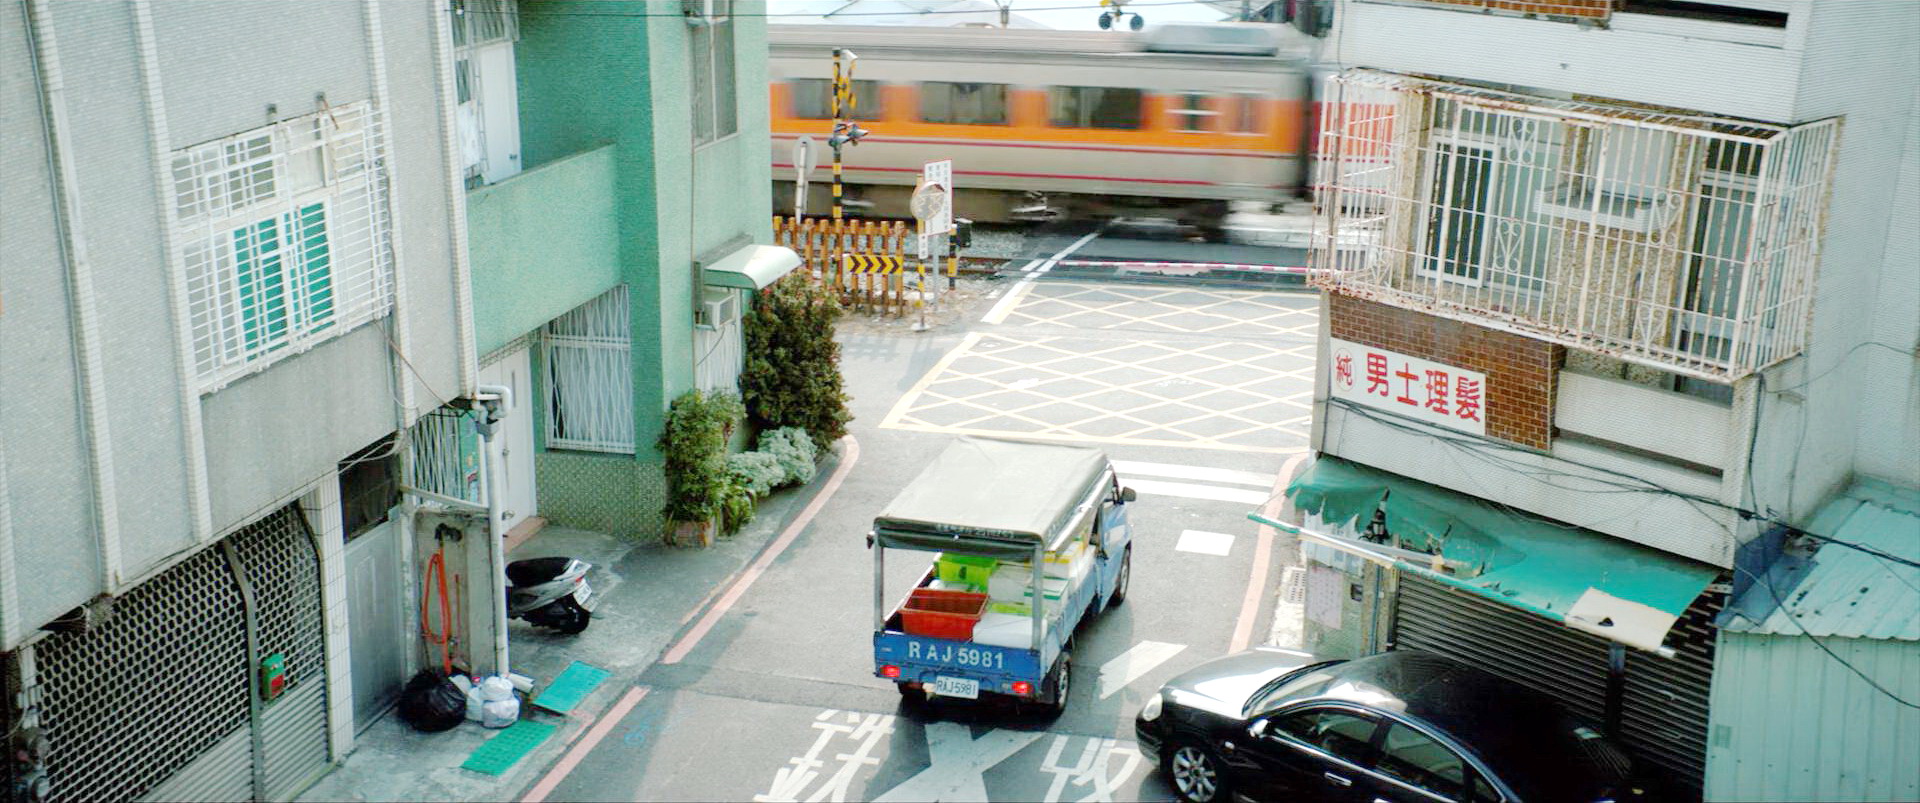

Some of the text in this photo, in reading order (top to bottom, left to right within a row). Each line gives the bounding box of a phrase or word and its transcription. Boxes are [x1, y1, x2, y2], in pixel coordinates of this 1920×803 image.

[1335, 352, 1481, 423] 純 男士理髮
